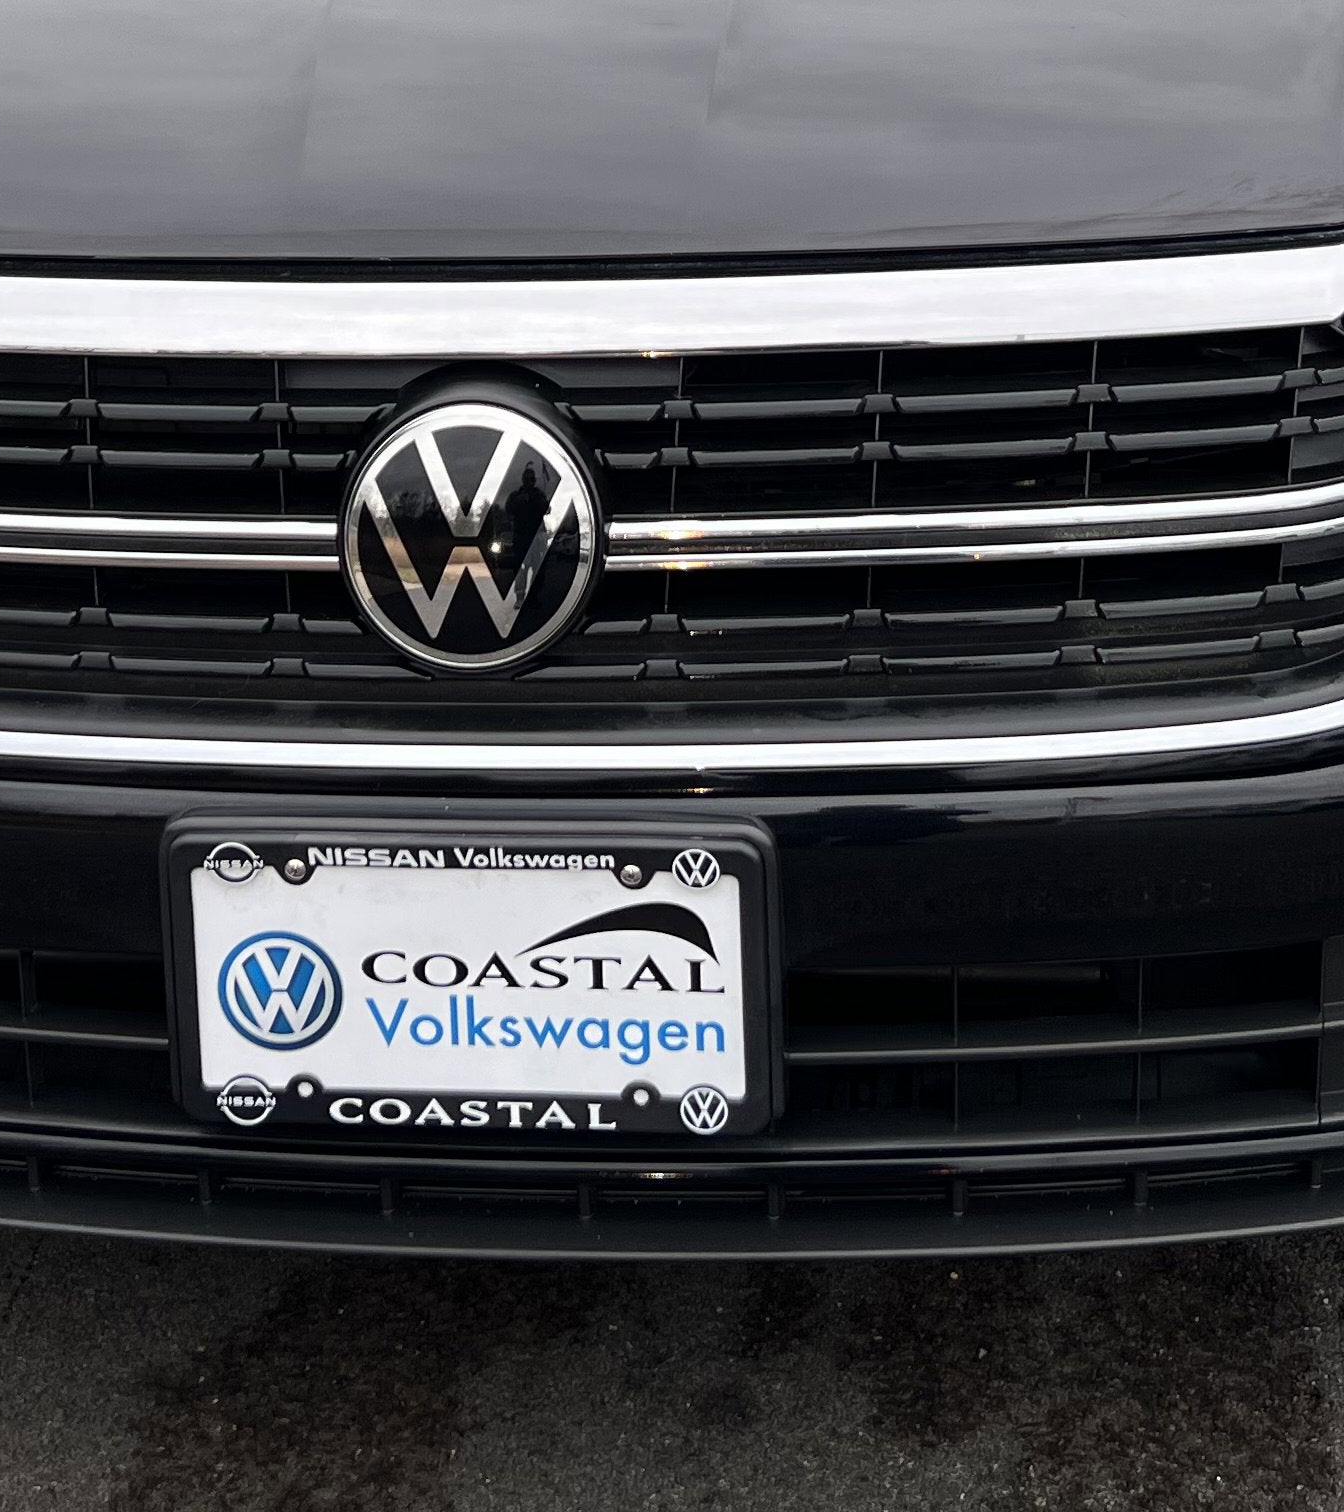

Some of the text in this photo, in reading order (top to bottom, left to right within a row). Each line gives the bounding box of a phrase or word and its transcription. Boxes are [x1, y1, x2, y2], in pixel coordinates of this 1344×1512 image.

[307, 846, 615, 871] NISSAN Volkswagen
[361, 950, 726, 994] COASTAL
[365, 994, 726, 1066] Volkswagen
[328, 1097, 617, 1130] COASTAL
